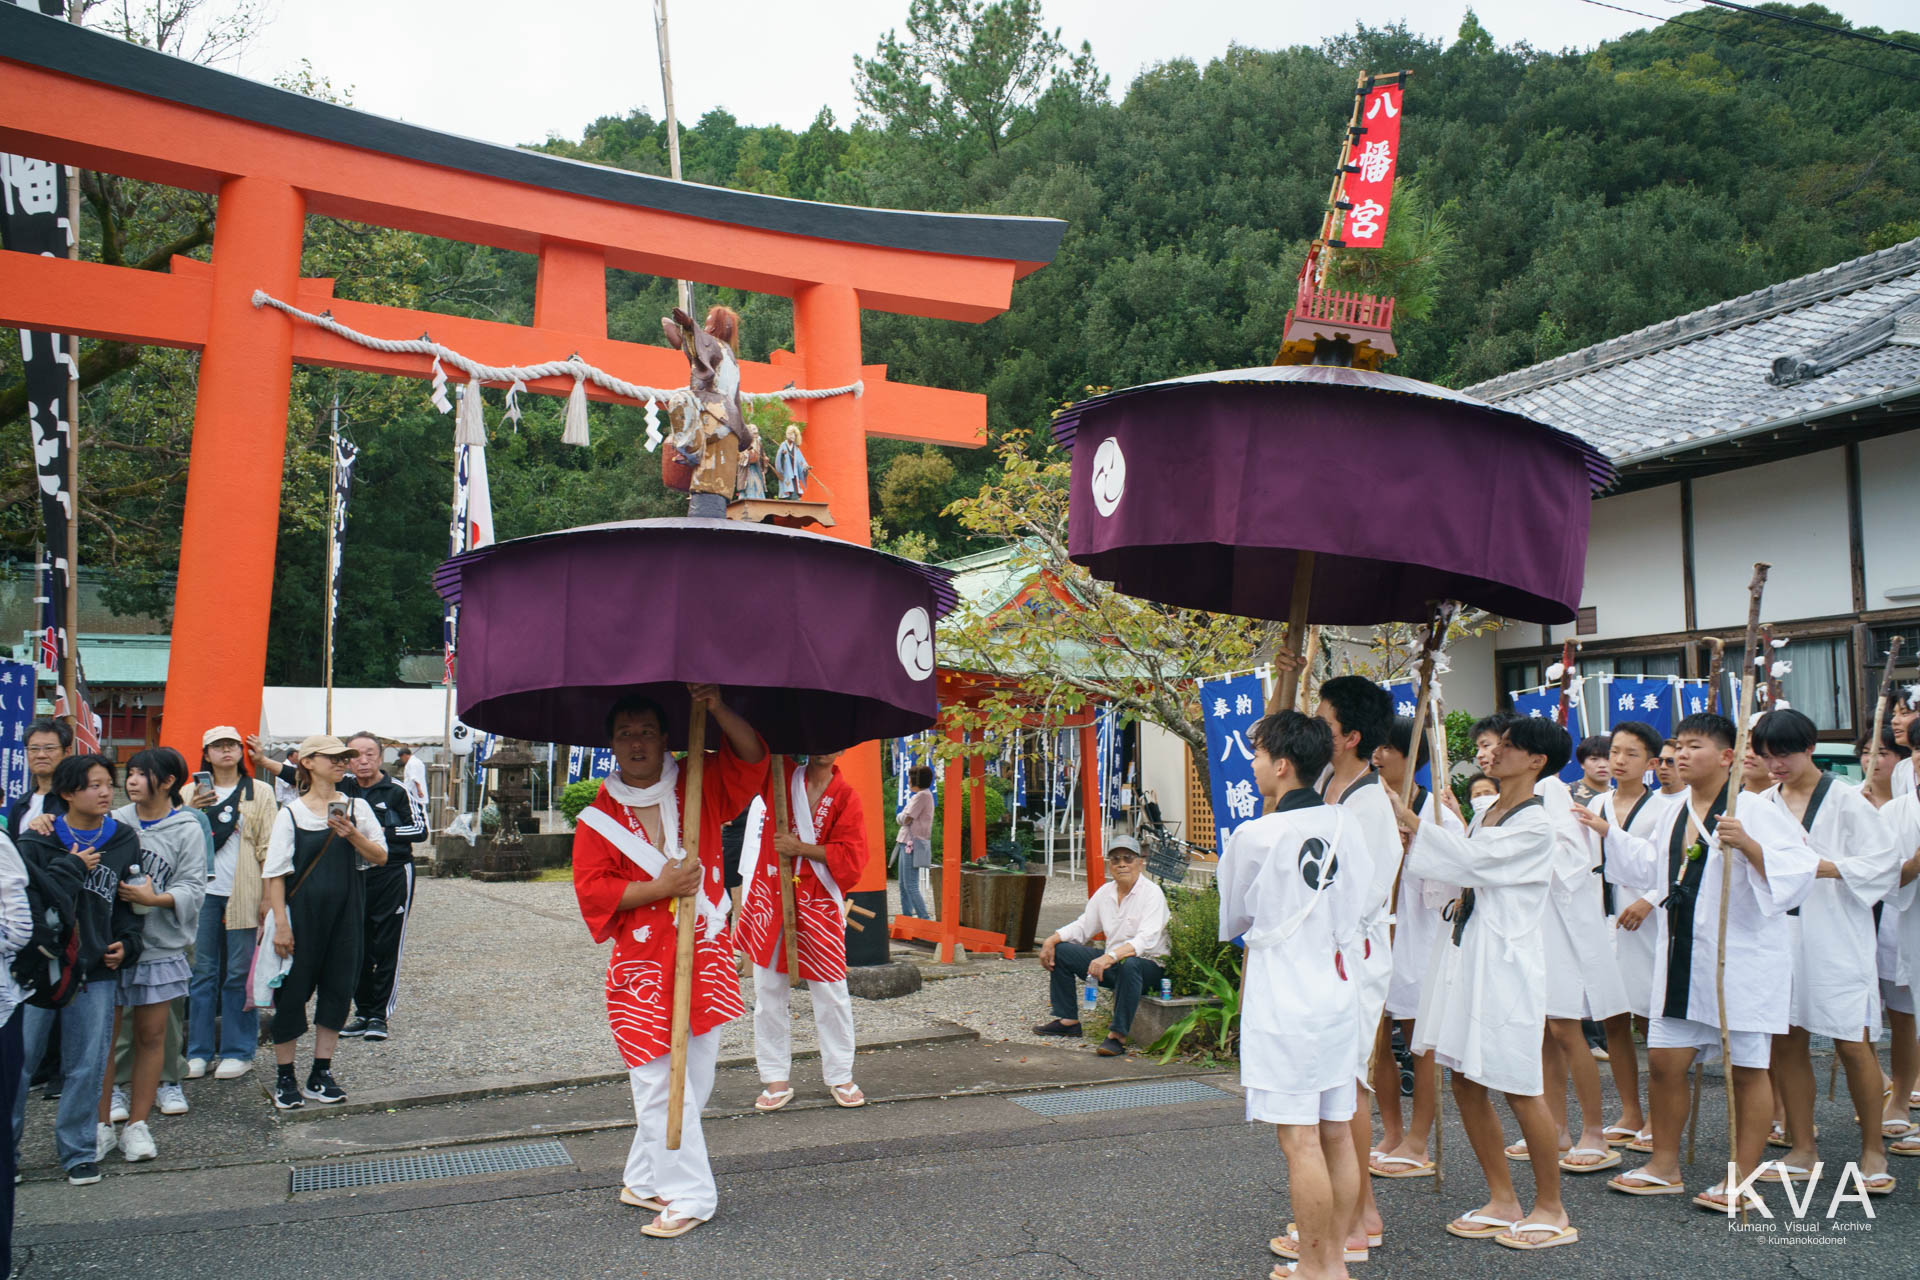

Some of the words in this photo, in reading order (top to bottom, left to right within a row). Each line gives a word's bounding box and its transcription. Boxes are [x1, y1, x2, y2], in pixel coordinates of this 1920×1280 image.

[1350, 92, 1398, 239] 八幡宮
[1212, 694, 1252, 719] 奉納
[1221, 729, 1259, 819] 八幡
